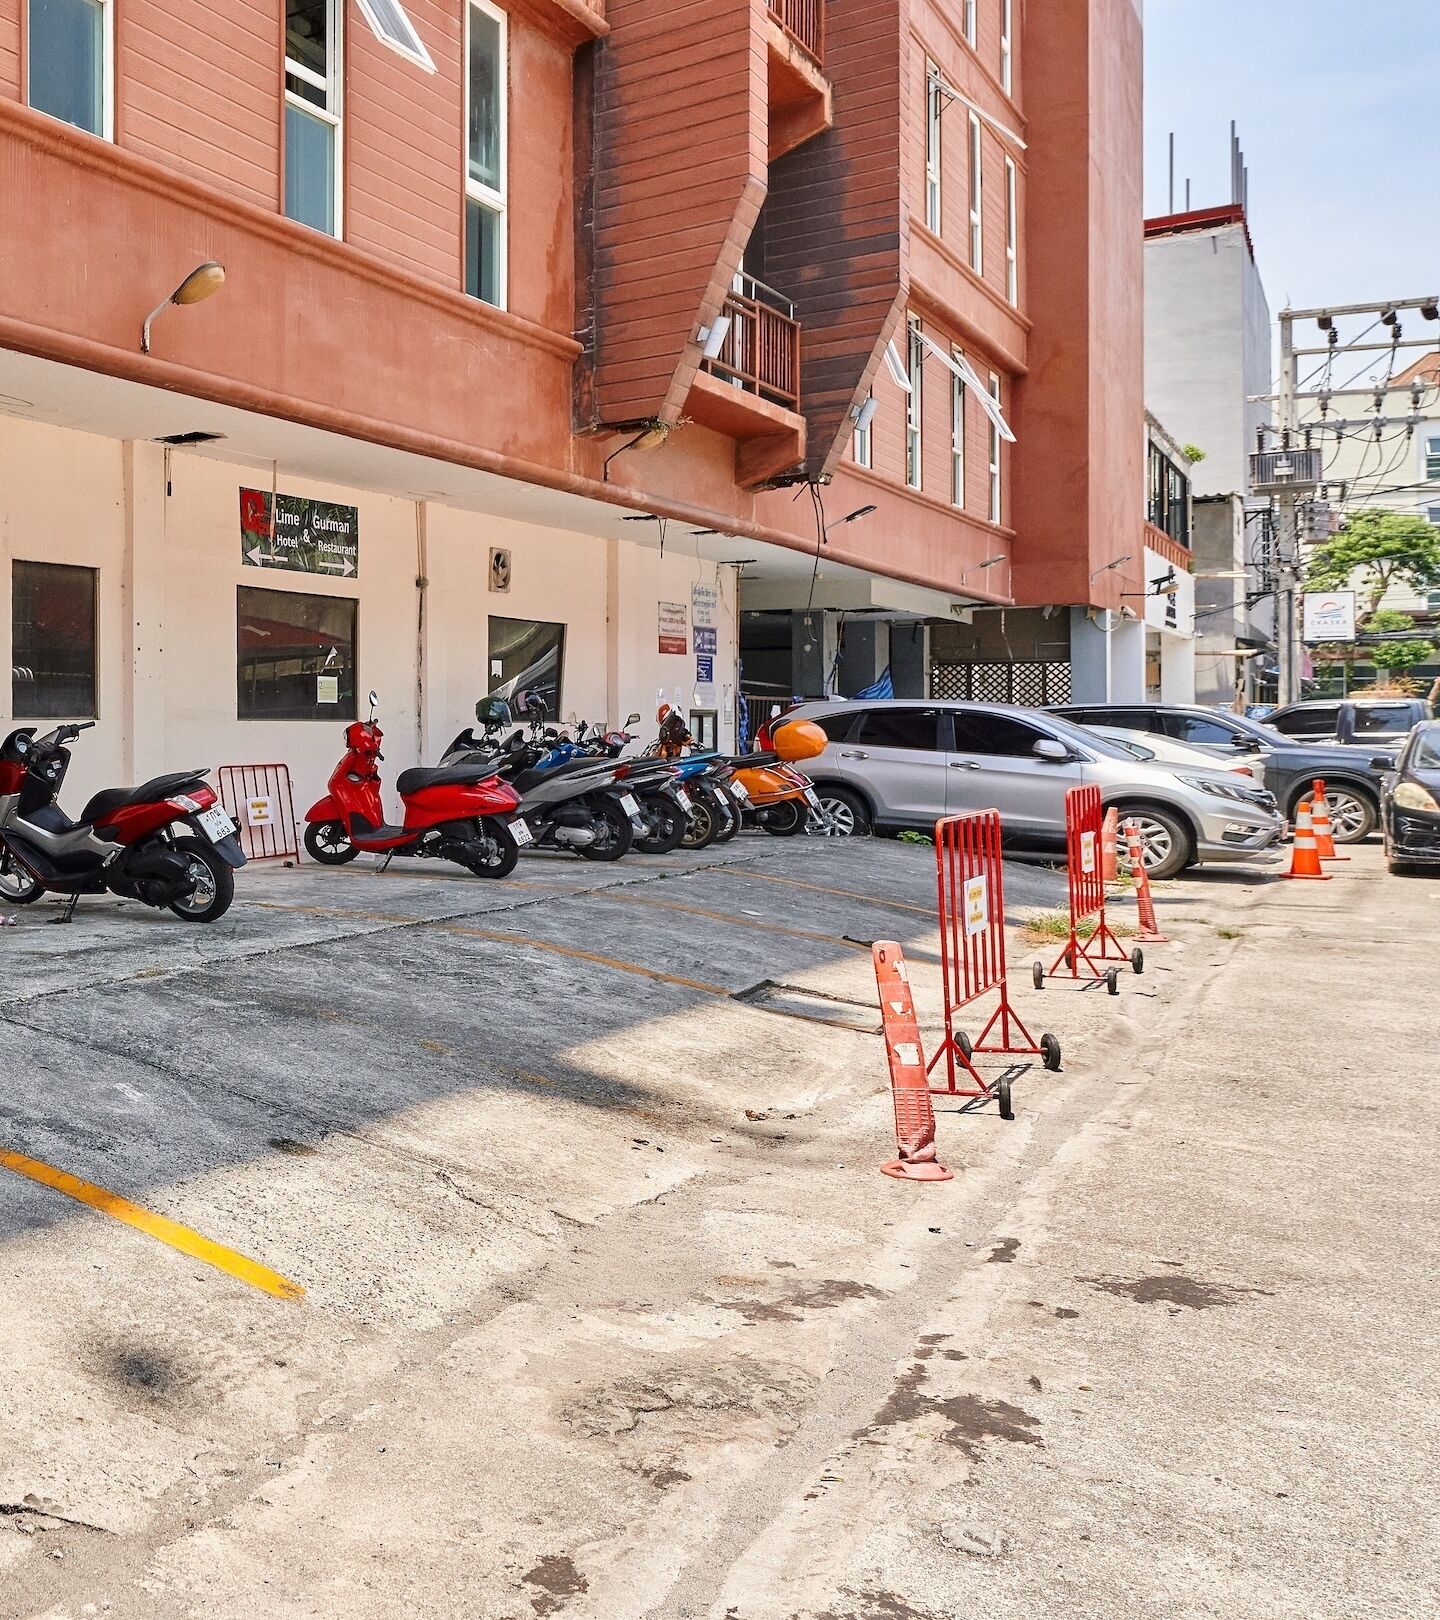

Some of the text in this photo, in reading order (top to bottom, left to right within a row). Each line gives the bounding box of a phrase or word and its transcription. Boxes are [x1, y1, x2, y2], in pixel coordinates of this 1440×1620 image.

[275, 508, 300, 526] Lime
[312, 514, 350, 534] Gurman
[276, 534, 299, 548] Hotel
[302, 528, 310, 543] &
[317, 540, 357, 556] Restaurant
